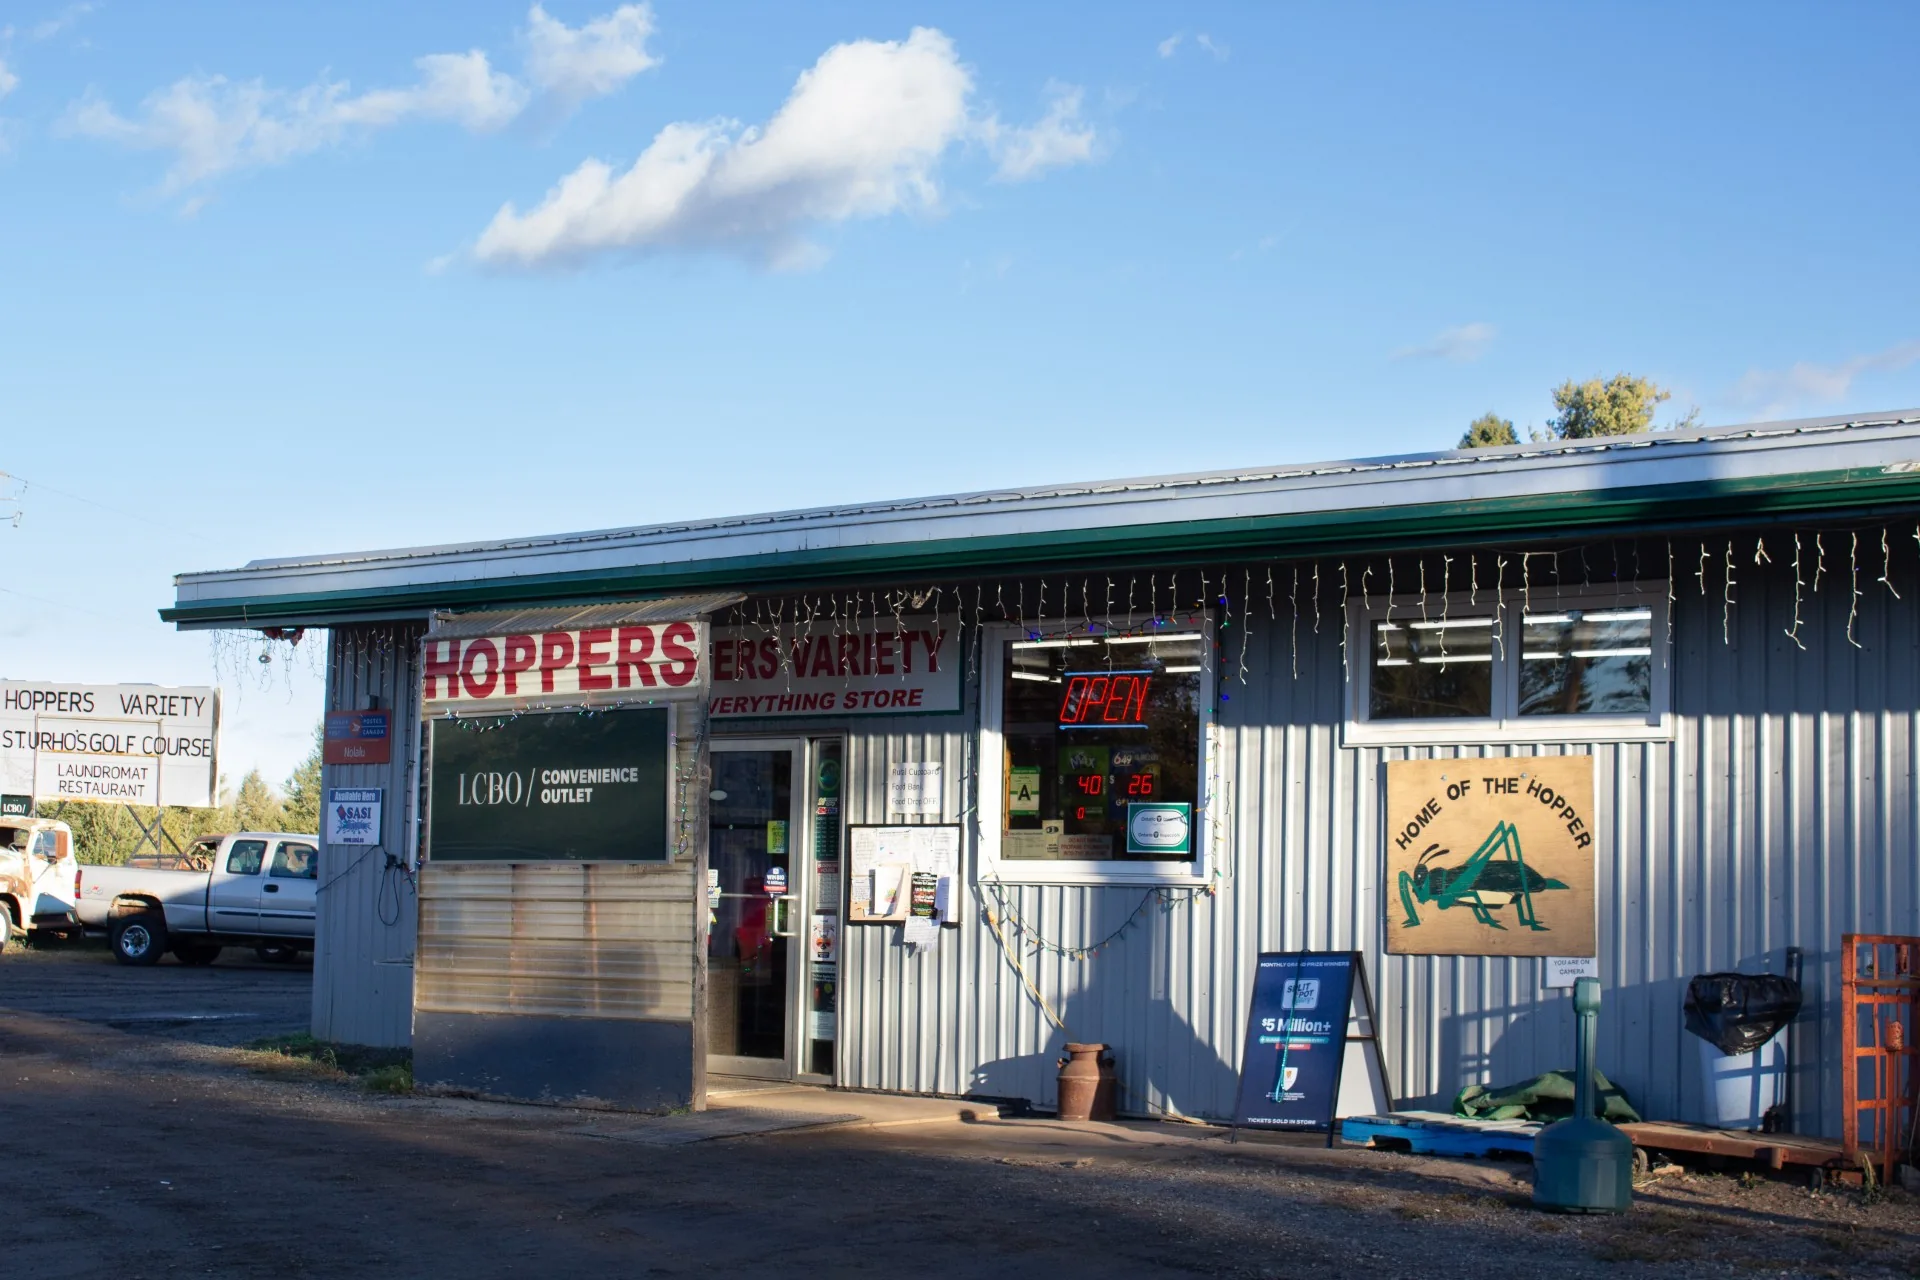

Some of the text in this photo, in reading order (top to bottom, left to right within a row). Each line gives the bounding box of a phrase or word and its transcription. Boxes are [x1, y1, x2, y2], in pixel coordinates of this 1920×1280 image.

[424, 622, 699, 699] HOPPERS
[713, 628, 948, 681] ERS VARIETY
[5, 689, 206, 717] HOPPERS VARIETY
[708, 688, 924, 715] VERYTHING STORE
[1060, 676, 1151, 723] OPEN
[90, 733, 136, 754] GOLF
[142, 735, 212, 757] COURSE
[1113, 752, 1132, 765] 649
[58, 763, 149, 780] LAUNDROMAT
[541, 767, 639, 786] CONVENIENCE
[59, 780, 146, 797] RESTAURANT
[891, 783, 906, 791] Food
[1018, 784, 1031, 801] A
[1078, 775, 1102, 794] 40
[1128, 774, 1153, 794] 26
[541, 787, 593, 804] OUTLET
[346, 807, 372, 819] SASI
[1395, 777, 1592, 850] HOME OF THE HOPPER
[1580, 958, 1590, 966] ON
[1298, 989, 1315, 998] POT
[1261, 1017, 1331, 1032] $5 Million+
